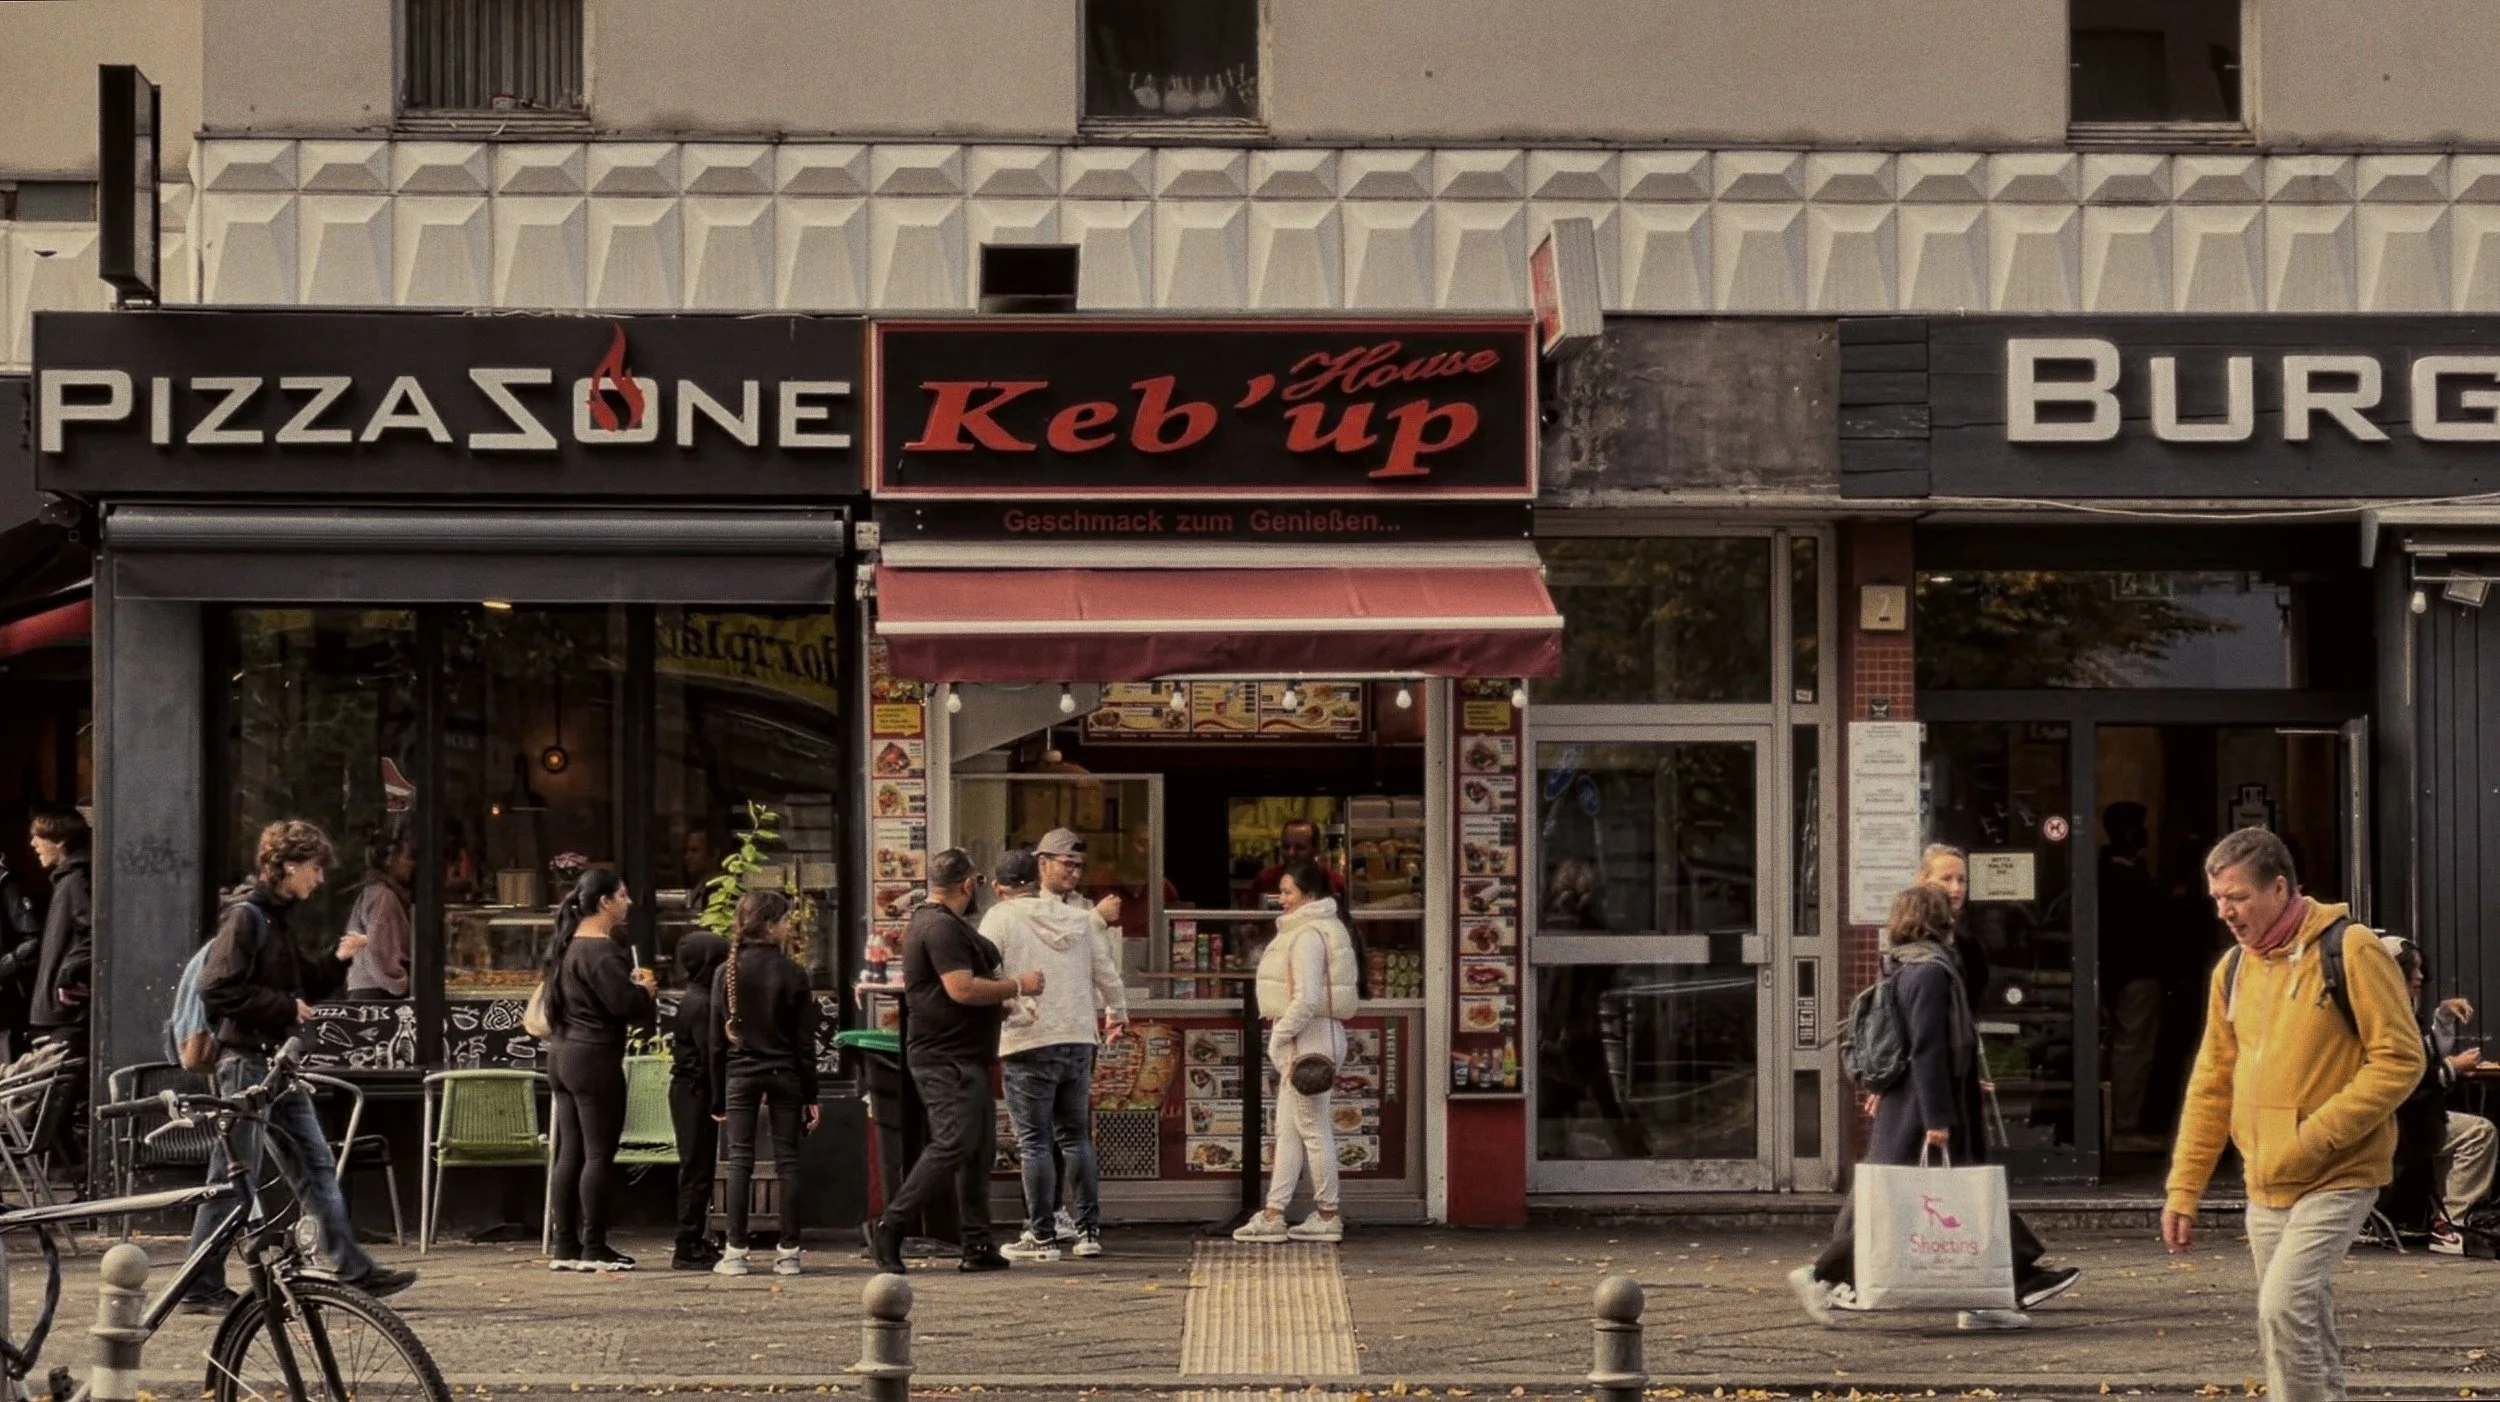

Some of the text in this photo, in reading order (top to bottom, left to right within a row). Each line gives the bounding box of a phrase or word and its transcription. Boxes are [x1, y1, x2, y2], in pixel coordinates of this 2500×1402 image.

[1281, 340, 1499, 401] House
[1004, 508, 1401, 533] Geschmack zum Genießen...
